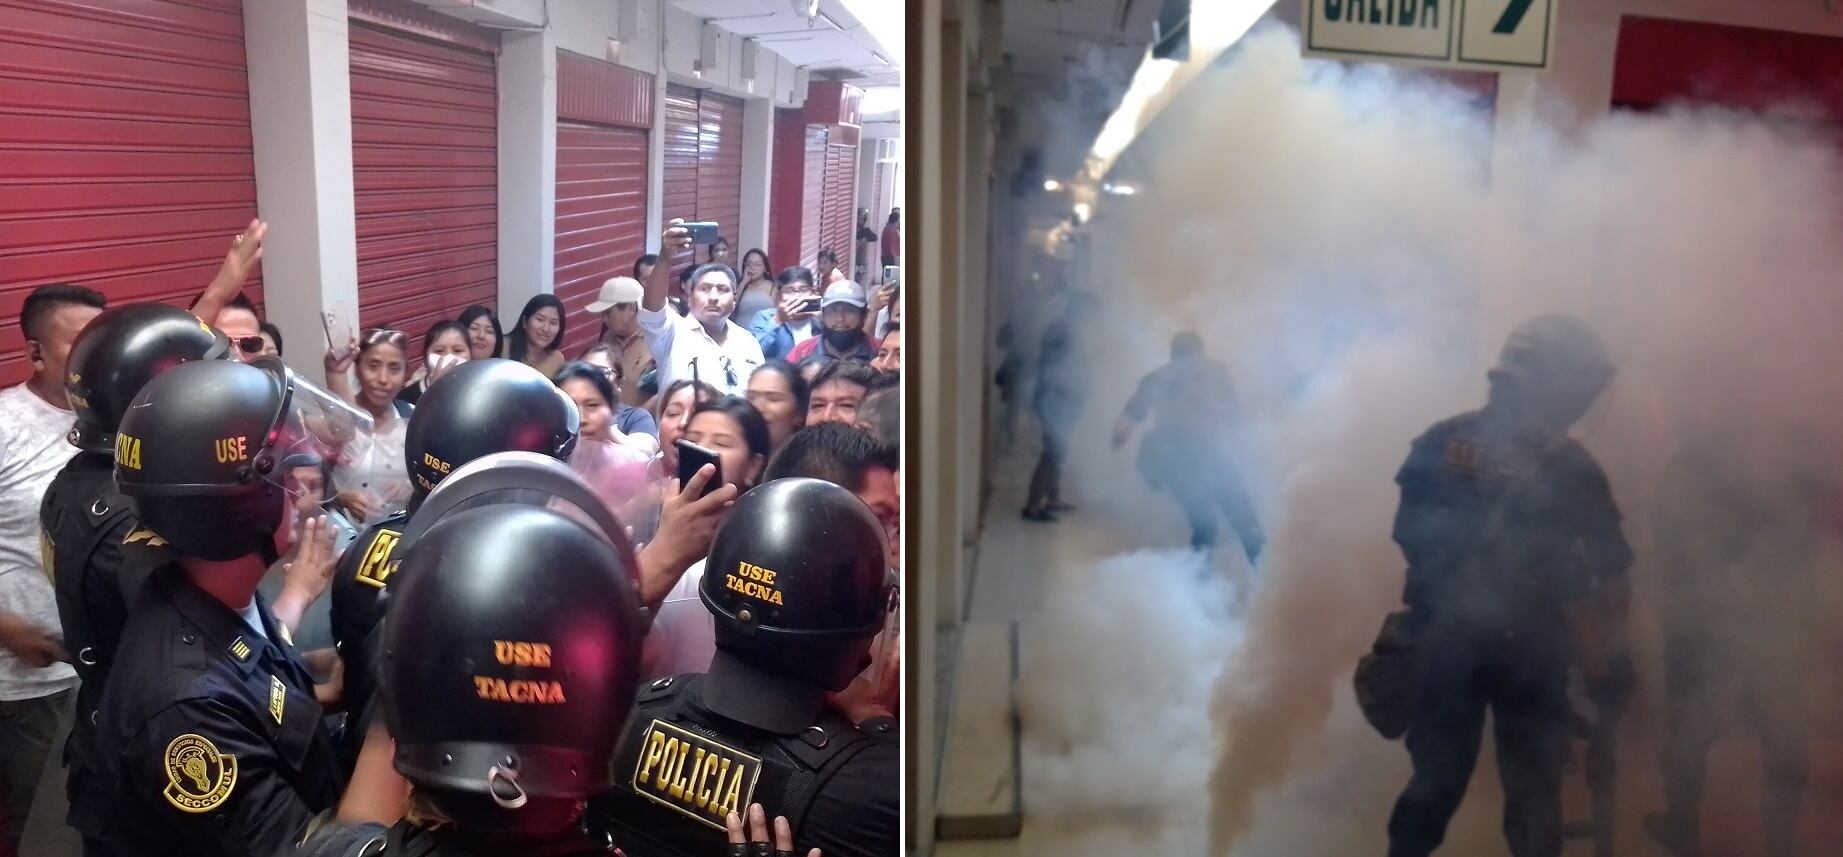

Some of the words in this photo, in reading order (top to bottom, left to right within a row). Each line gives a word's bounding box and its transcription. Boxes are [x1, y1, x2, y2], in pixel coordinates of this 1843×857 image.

[115, 432, 142, 470] CNA
[215, 436, 248, 463] USE
[424, 452, 451, 475] USE
[739, 560, 777, 585] USE
[726, 573, 784, 606] TACNA
[493, 639, 552, 668] USE
[473, 674, 567, 704] TACNA
[175, 767, 233, 808] SECCOMUL
[640, 730, 745, 815] POLICIA
